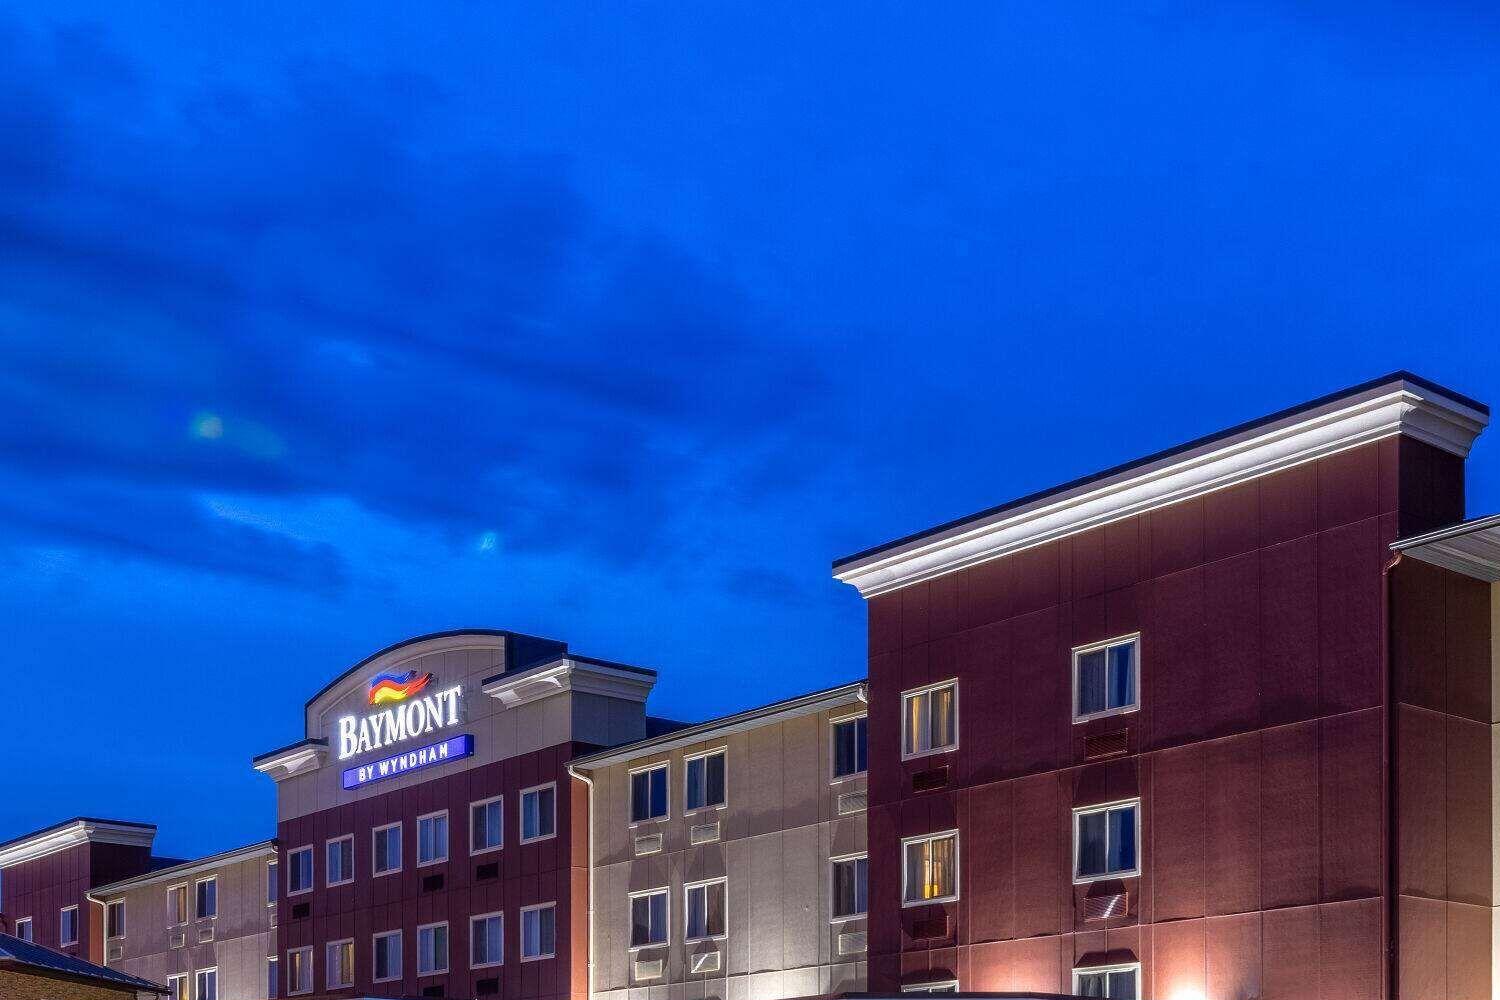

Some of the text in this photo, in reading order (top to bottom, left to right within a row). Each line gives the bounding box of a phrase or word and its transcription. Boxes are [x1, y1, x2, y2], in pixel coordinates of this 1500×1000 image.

[338, 685, 462, 760] BAYMONT
[358, 742, 449, 783] BY WYNDHAM
